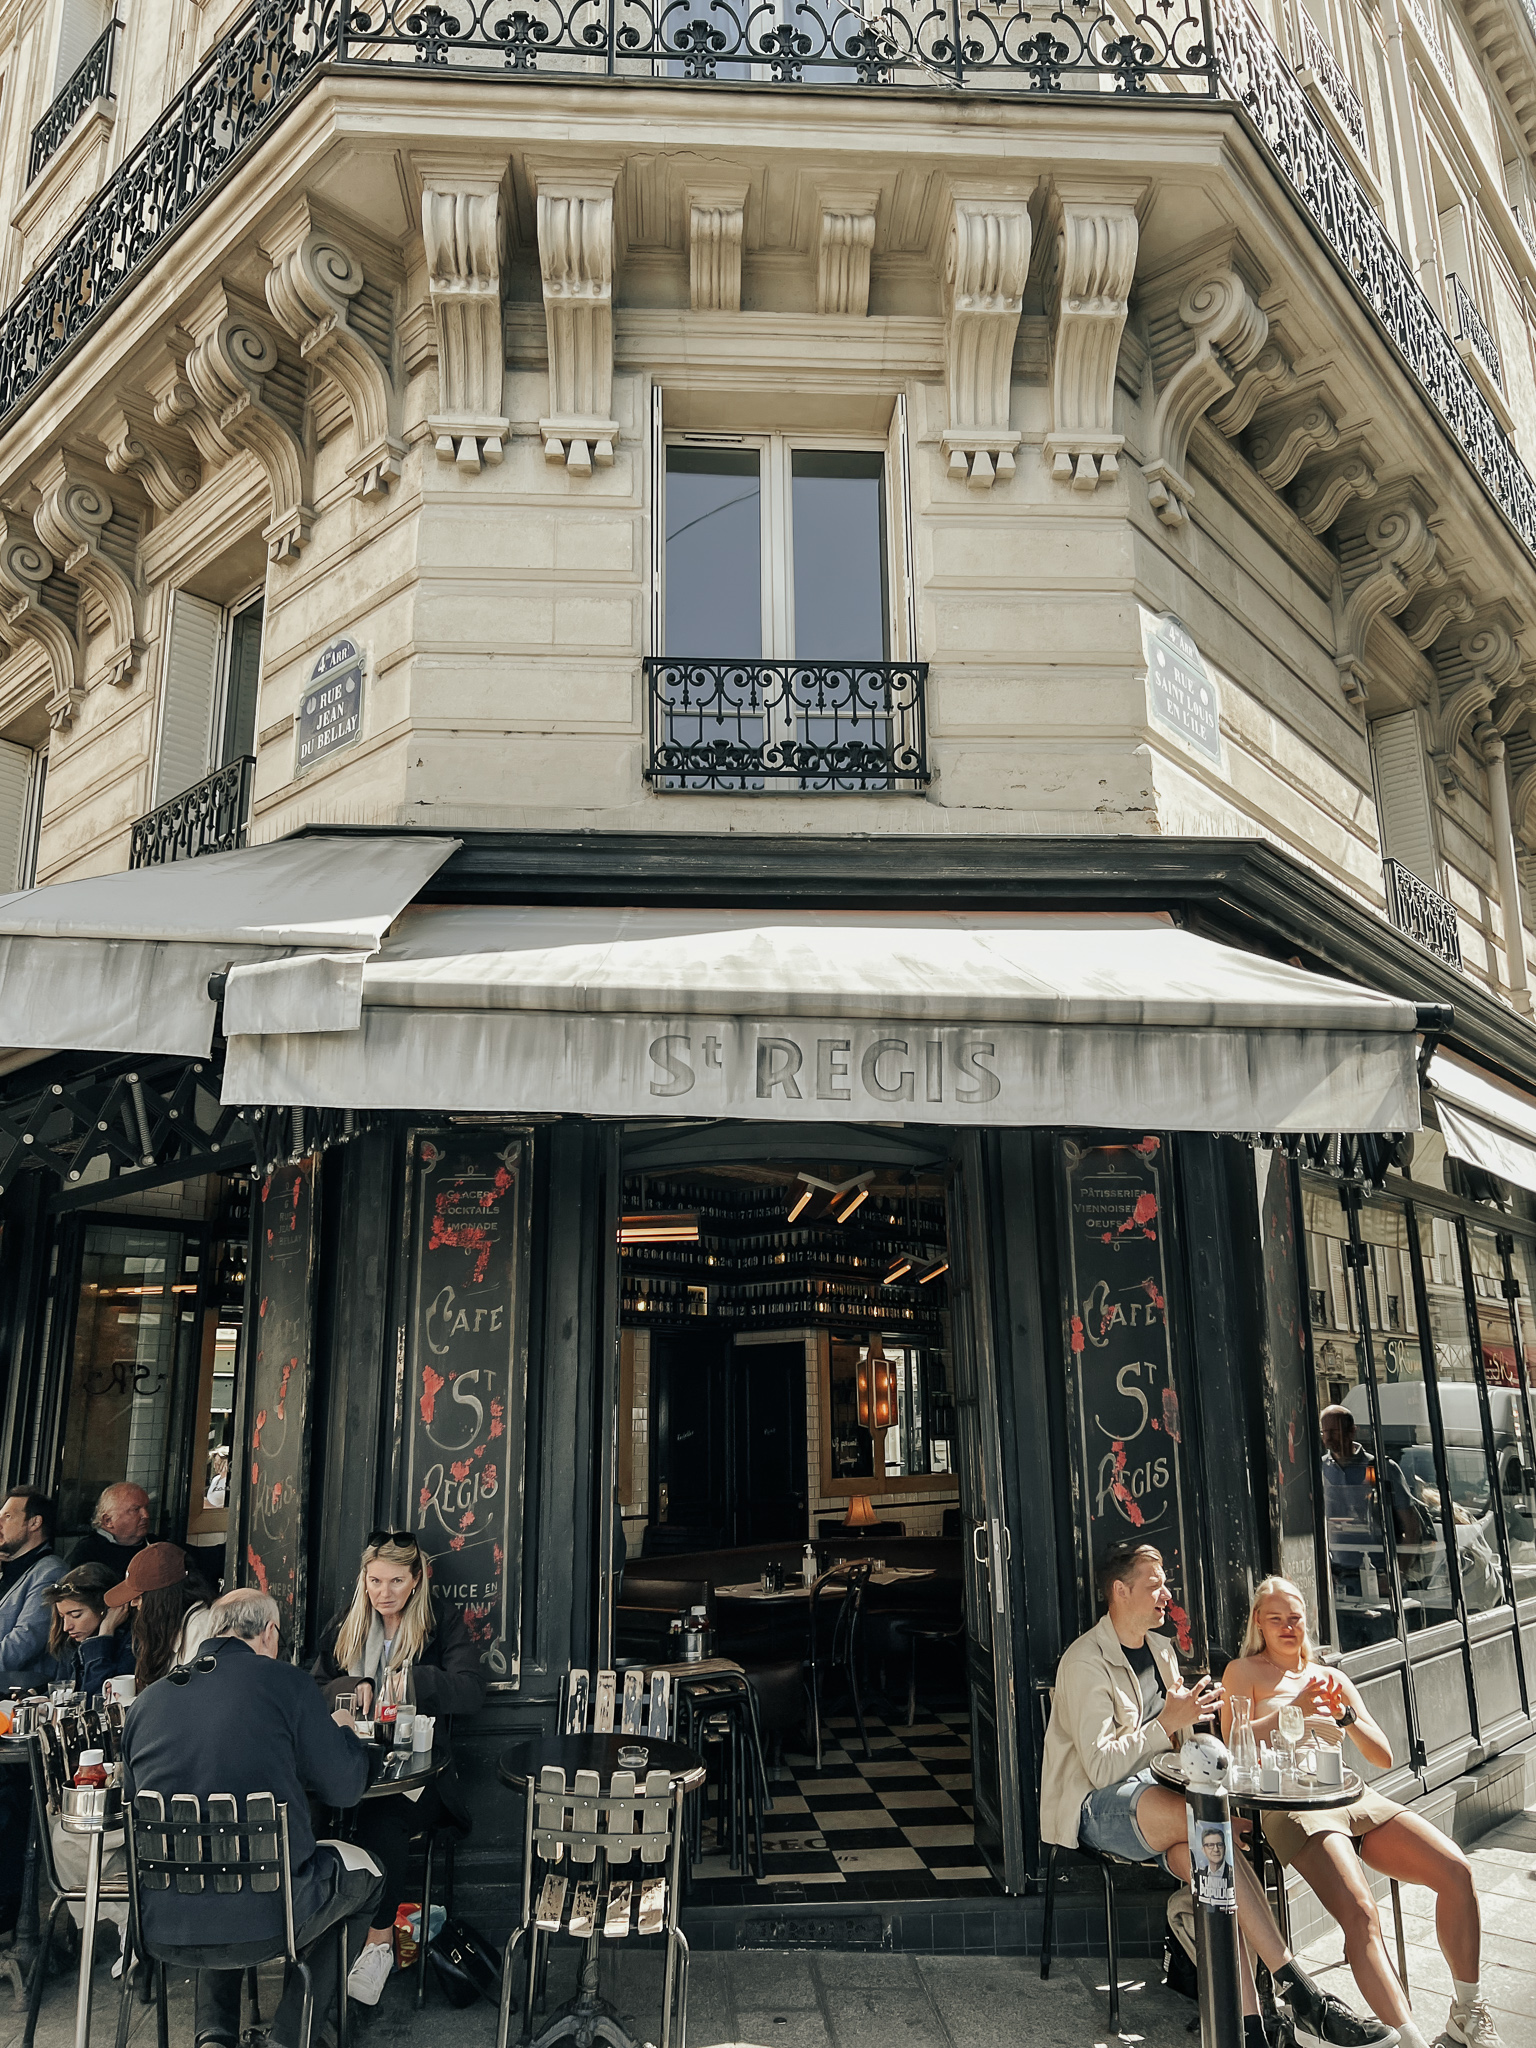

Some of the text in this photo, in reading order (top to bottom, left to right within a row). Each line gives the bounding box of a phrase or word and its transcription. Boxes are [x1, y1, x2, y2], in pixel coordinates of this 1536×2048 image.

[1173, 666, 1195, 695] RUE
[319, 683, 343, 710] RUE
[1155, 670, 1215, 729] SAINT LOUIS
[1166, 699, 1181, 720] EN
[316, 701, 345, 731] JEAN
[300, 713, 359, 760] DU BELLAY
[648, 1034, 1002, 1104] St REGIS
[442, 1222, 499, 1231] IMONADE
[484, 1581, 498, 1598] EN
